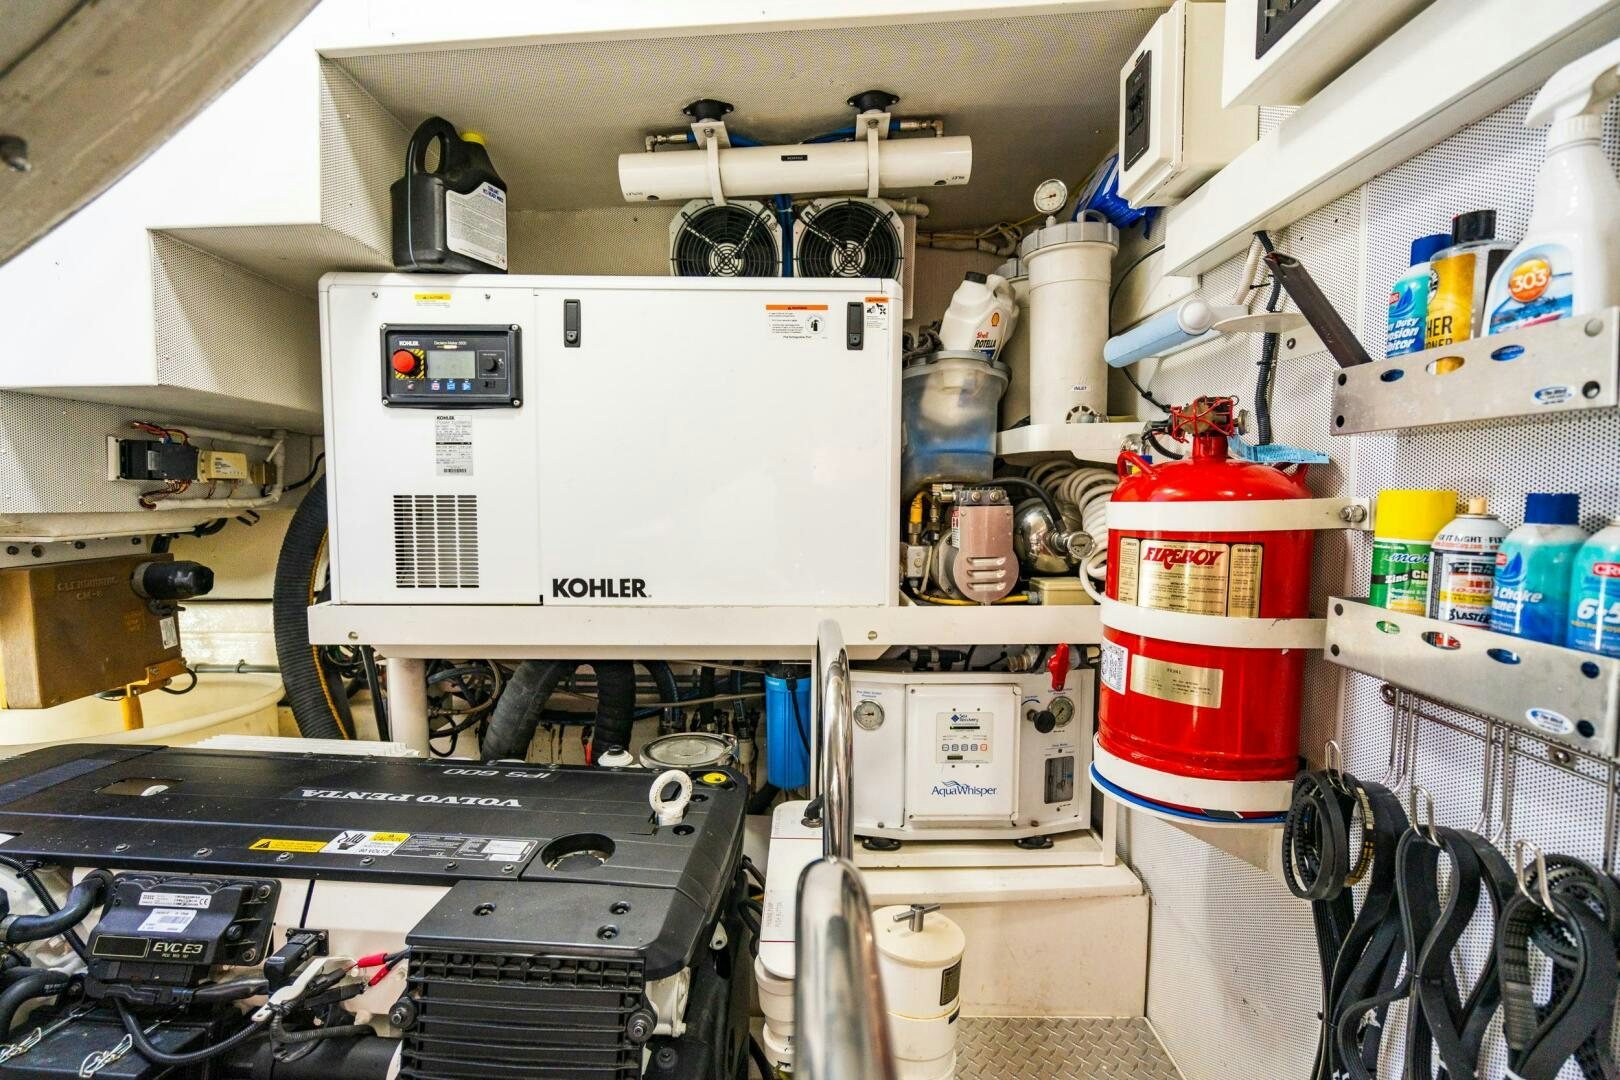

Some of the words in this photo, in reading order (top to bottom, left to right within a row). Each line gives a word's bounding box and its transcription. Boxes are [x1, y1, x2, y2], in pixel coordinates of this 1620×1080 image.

[1512, 268, 1547, 293] 303
[976, 331, 989, 339] Shell
[974, 339, 997, 348] ROTELLA
[1143, 547, 1224, 571] FIREBOY
[1385, 574, 1409, 584] Zinc
[552, 578, 647, 598] KOHLER
[442, 768, 499, 777] 600
[505, 770, 552, 779] IPS
[301, 789, 415, 802] PENTA
[931, 784, 997, 797] AquaWhisper
[416, 794, 523, 808] VOLVO
[152, 942, 183, 953] EVC
[183, 943, 203, 954] E3
